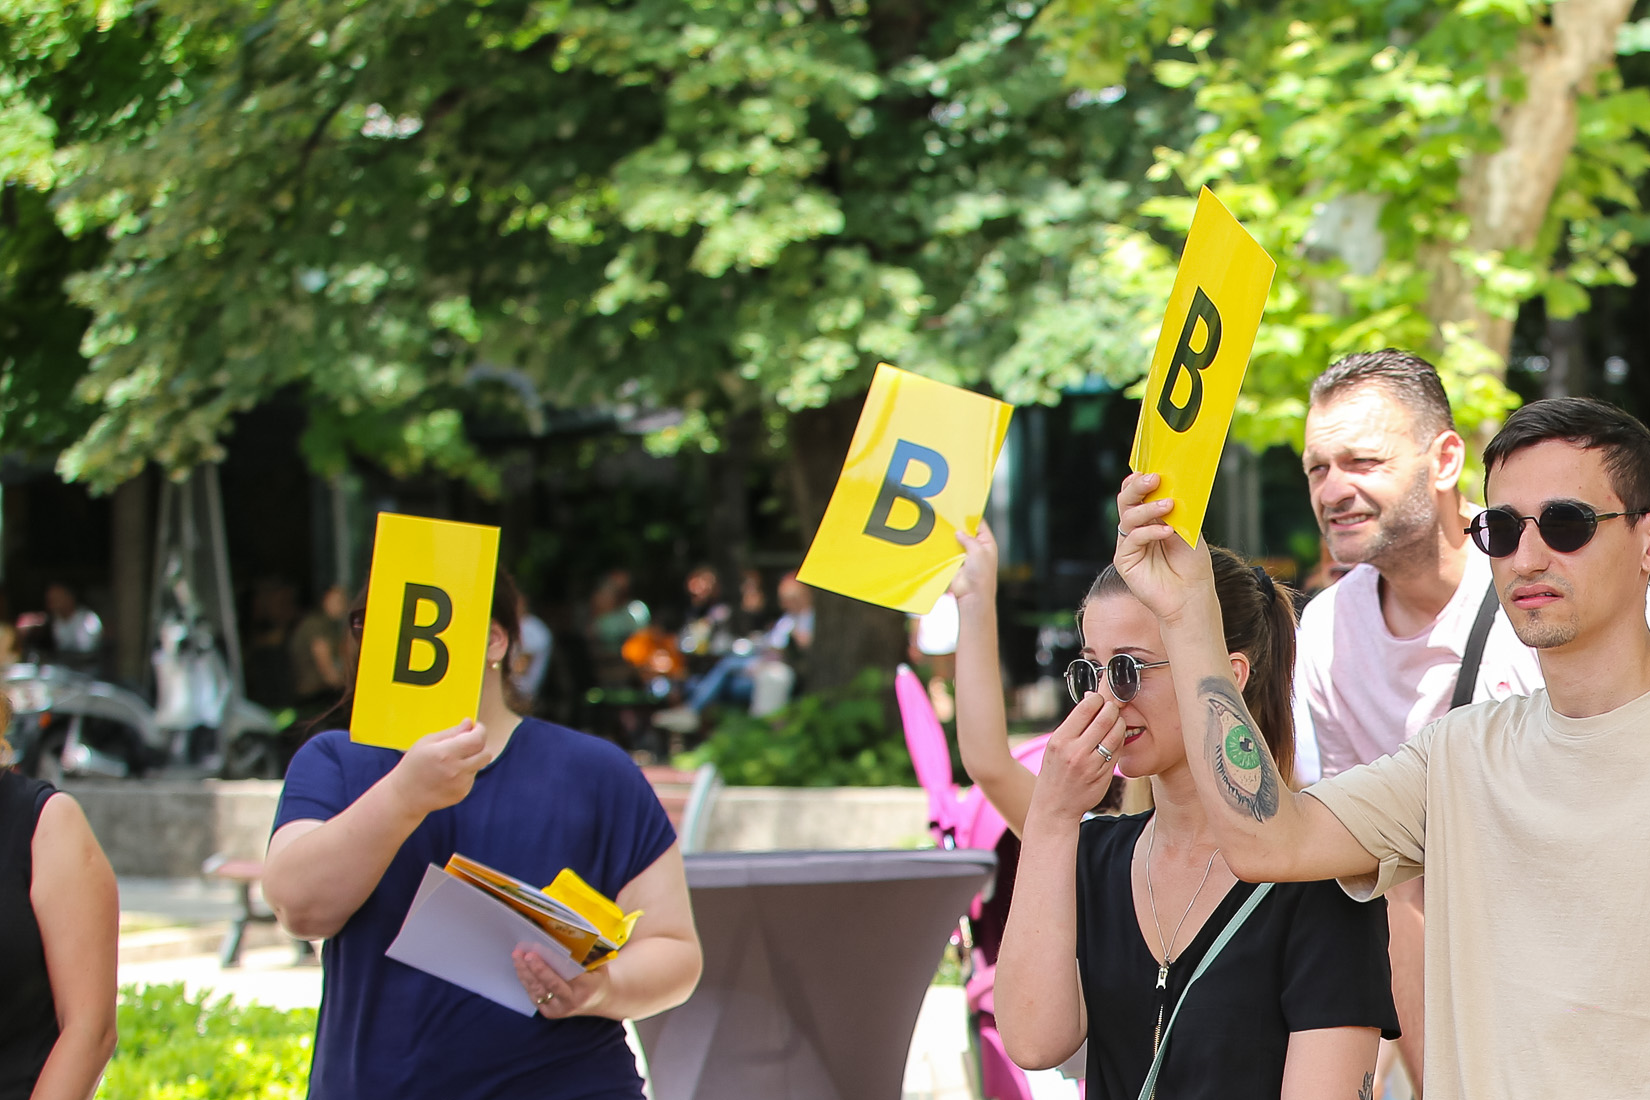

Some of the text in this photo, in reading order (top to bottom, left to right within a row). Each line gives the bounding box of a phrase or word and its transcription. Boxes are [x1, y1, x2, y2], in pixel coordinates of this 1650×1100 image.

[1156, 286, 1222, 432] B
[864, 439, 949, 545] B
[393, 583, 452, 686] B
